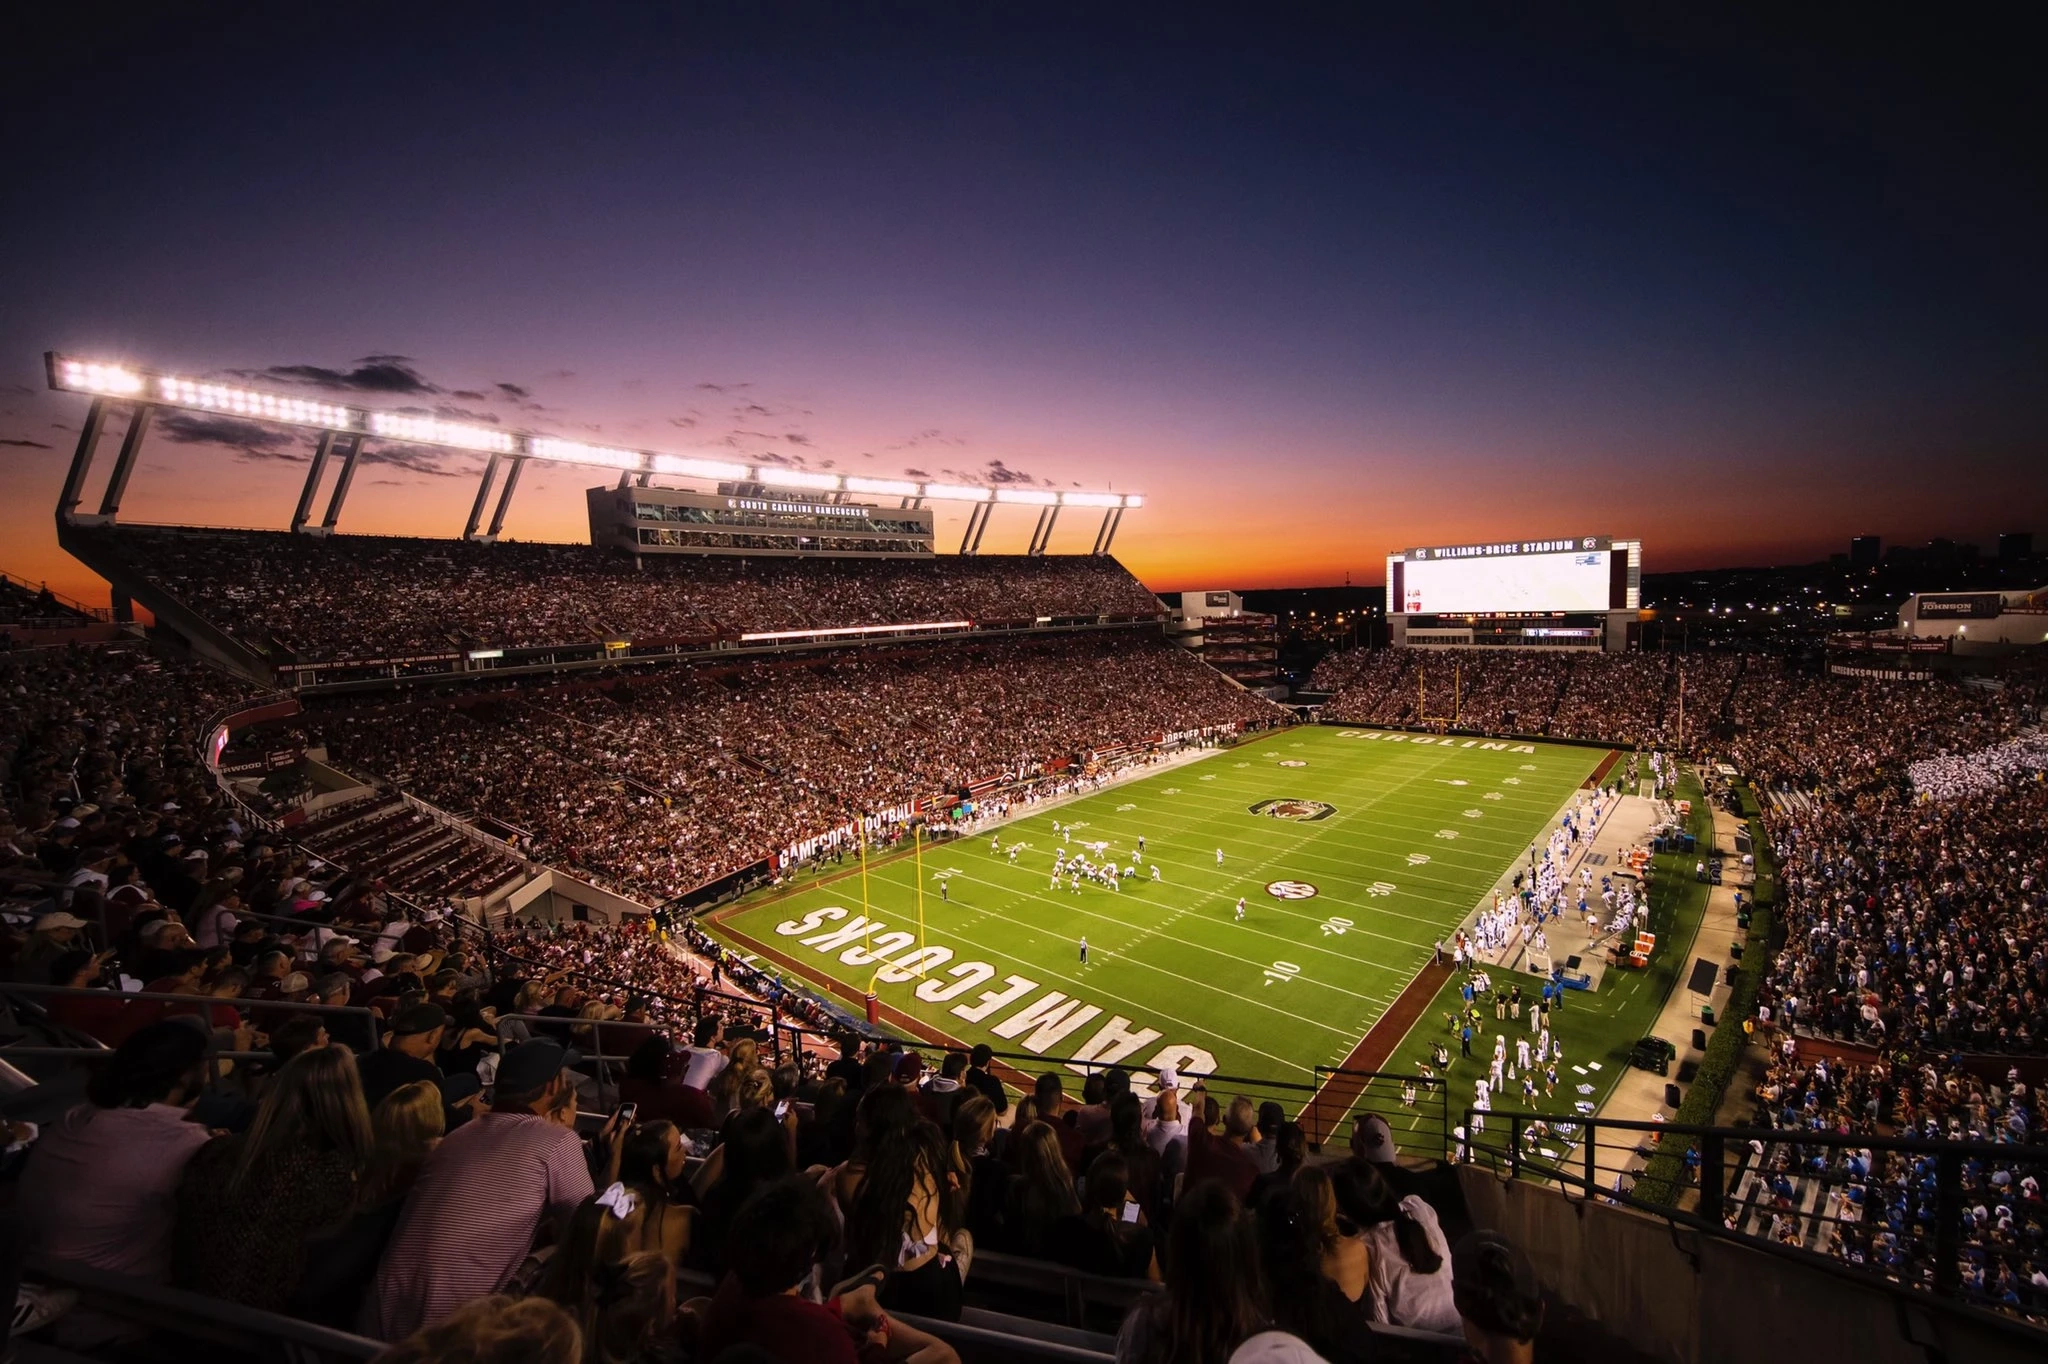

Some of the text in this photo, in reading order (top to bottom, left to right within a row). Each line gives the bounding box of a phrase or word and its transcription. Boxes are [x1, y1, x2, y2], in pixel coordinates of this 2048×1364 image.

[740, 500, 860, 516] SOUTH CAROLINA GAMECOCKS
[1434, 540, 1574, 558] WILLIAMS-BRICE STADIUM
[1202, 726, 1213, 737] TO
[1335, 731, 1536, 754] CAROLINA
[221, 762, 262, 774] RWOOD
[779, 802, 915, 869] GAMECOCK FOOTBALL
[1366, 881, 1397, 896] 30
[1320, 916, 1354, 935] 20
[1264, 961, 1301, 982] 10
[774, 905, 1219, 1103] GAMECOCKS
